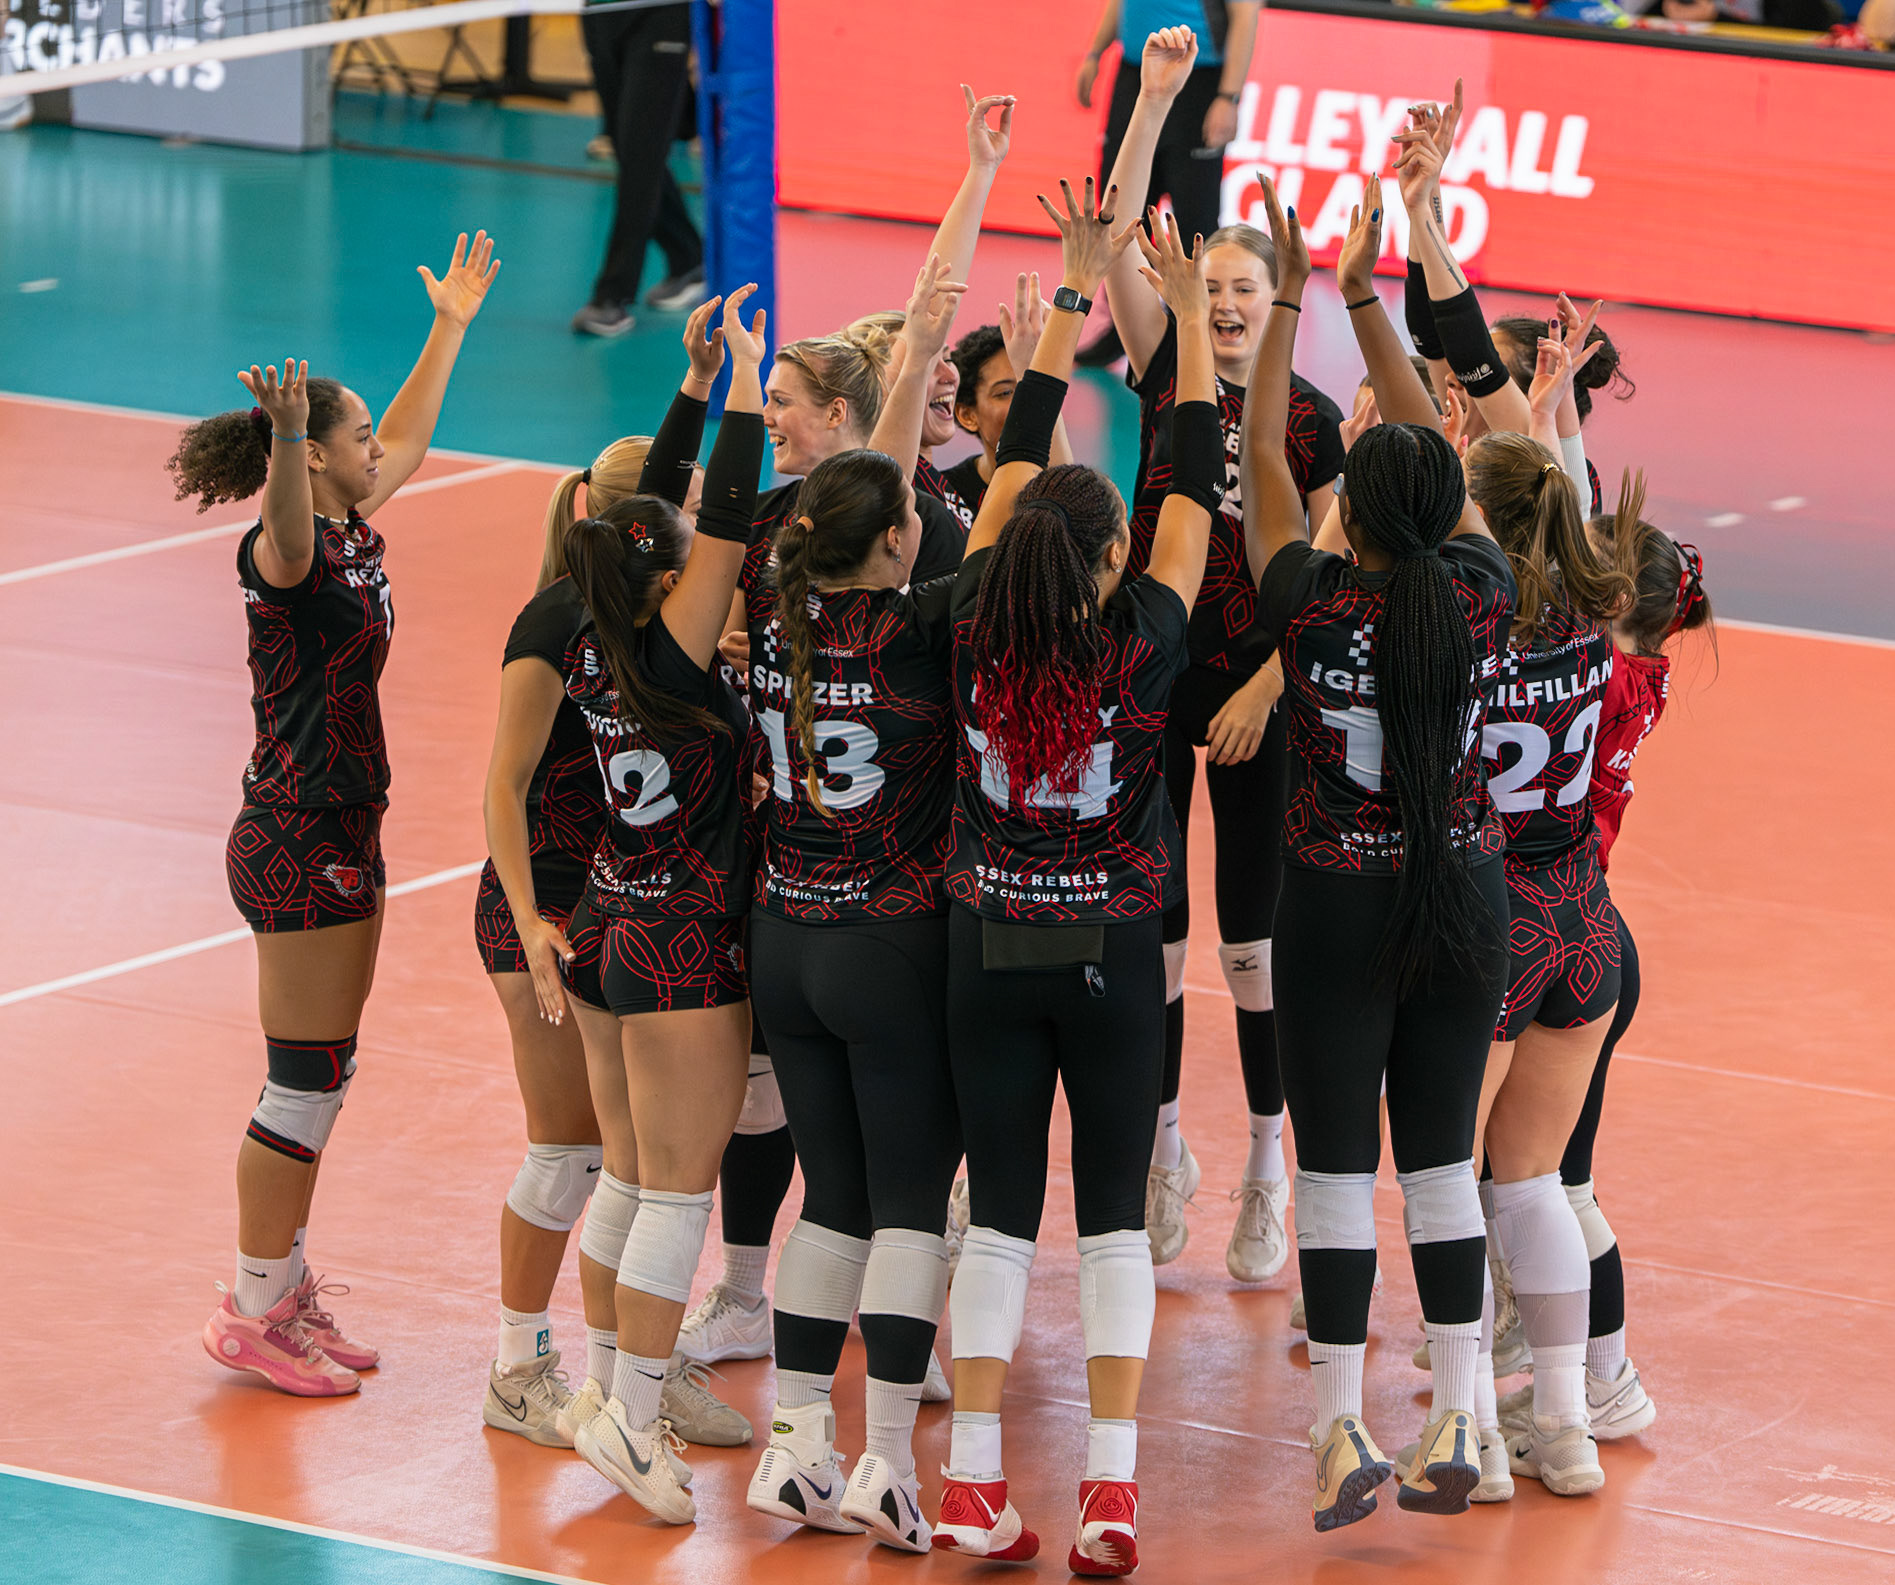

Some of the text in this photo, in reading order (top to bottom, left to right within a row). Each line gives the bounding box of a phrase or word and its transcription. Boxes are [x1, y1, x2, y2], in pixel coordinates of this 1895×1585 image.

[1225, 82, 1594, 198] LLEYALL
[1574, 633, 1599, 648] Essex
[753, 664, 875, 706] SPIZER
[755, 706, 885, 809] 13
[1481, 700, 1603, 813] 22
[779, 886, 830, 904] CURIOUS
[1031, 872, 1108, 888] REBELS
[1000, 888, 1060, 903] CURIOUS
[1065, 890, 1109, 903] BRAVE
